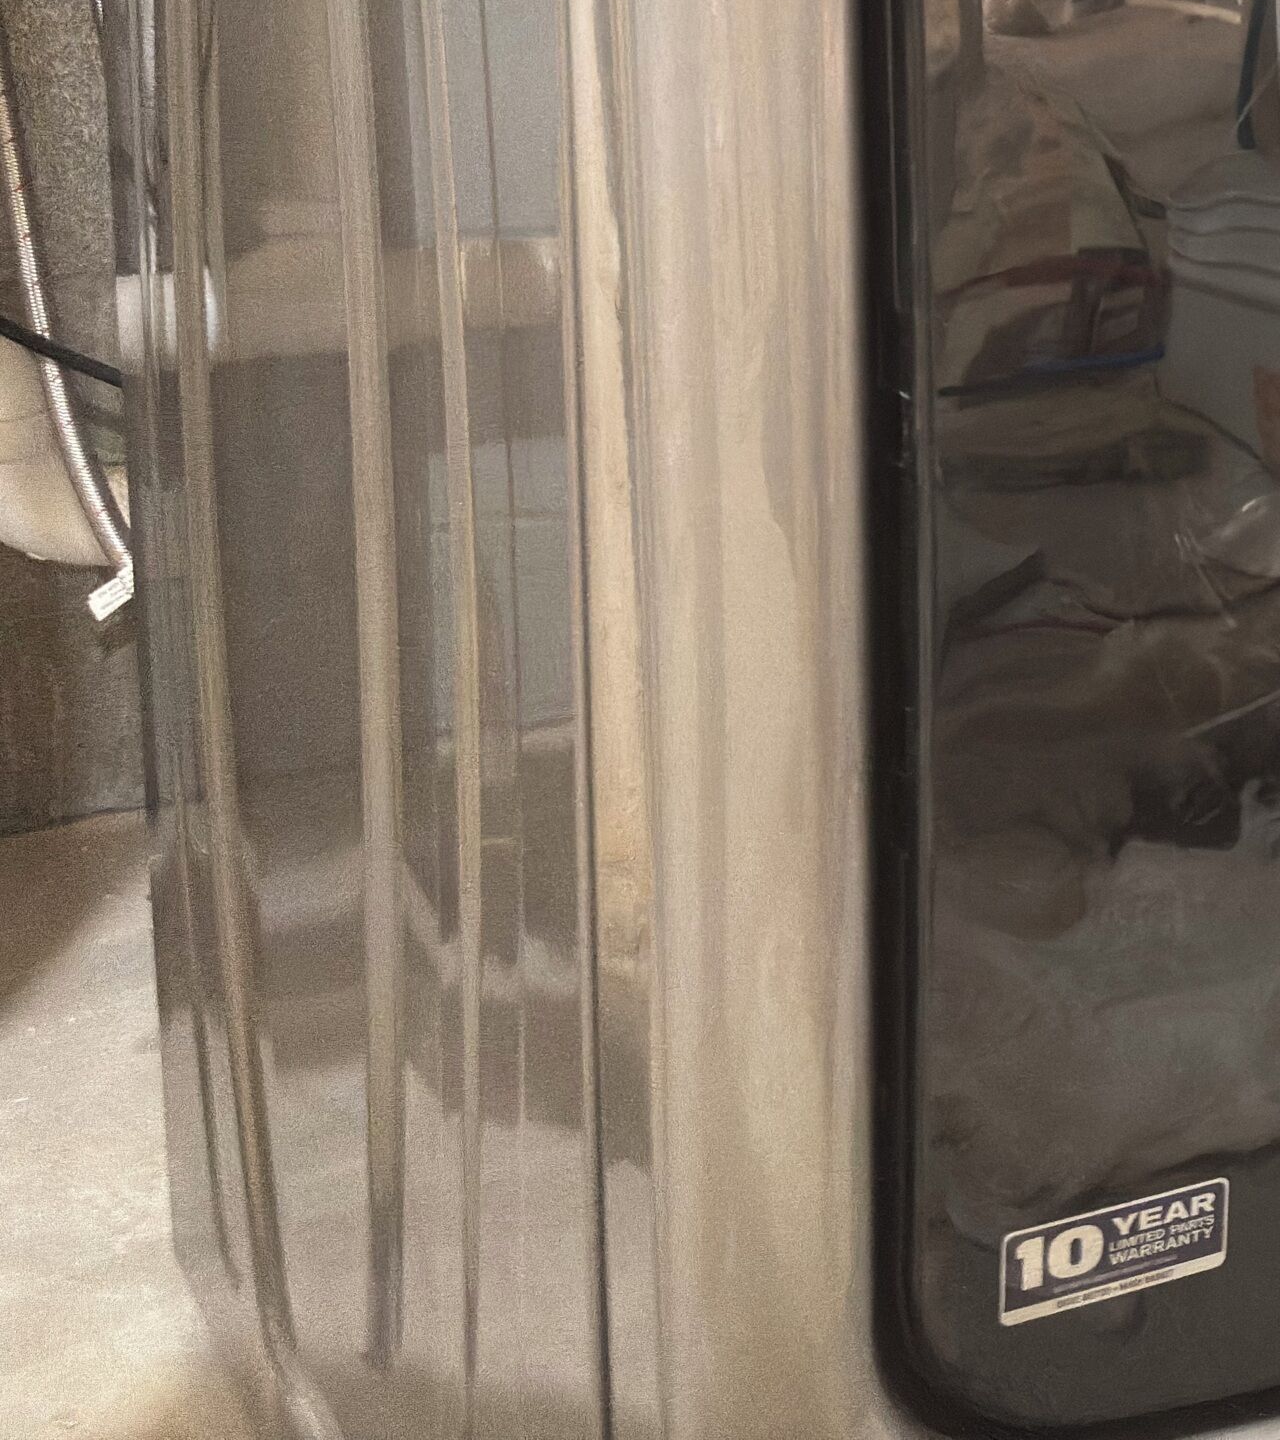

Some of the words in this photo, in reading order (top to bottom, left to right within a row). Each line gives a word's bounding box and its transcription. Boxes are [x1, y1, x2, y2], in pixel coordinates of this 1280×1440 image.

[1111, 1192, 1216, 1236] YEAR
[1014, 1223, 1105, 1292] 10
[1108, 1227, 1215, 1265] WARRANTY
[1109, 1228, 1166, 1253] LIMITED
